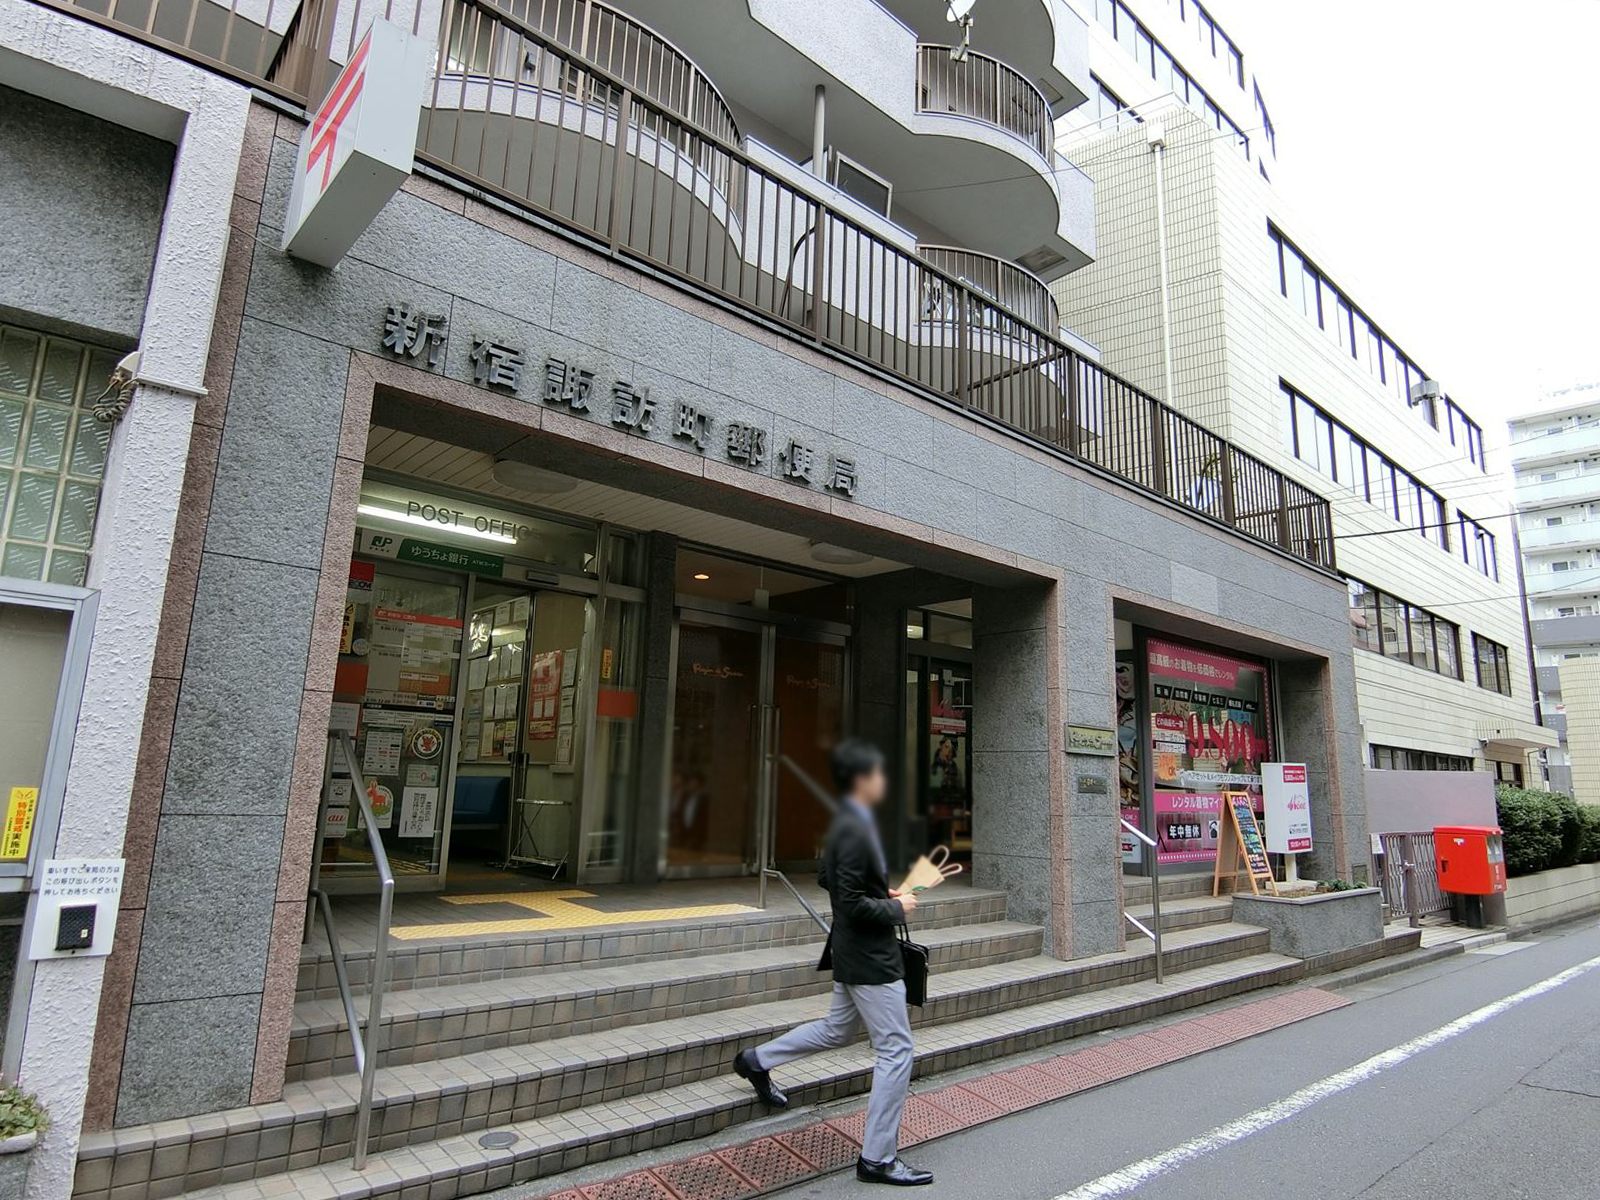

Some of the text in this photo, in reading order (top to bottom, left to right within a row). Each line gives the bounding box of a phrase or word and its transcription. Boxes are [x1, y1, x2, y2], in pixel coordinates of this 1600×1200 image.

[382, 302, 858, 498] 新宿諏訪町郵便局
[407, 501, 463, 527] POST
[411, 544, 469, 566] ゆうちょ銀行
[327, 814, 346, 822] au
[1169, 825, 1200, 839] 年中無休
[43, 886, 118, 896] 押してお待ちください
